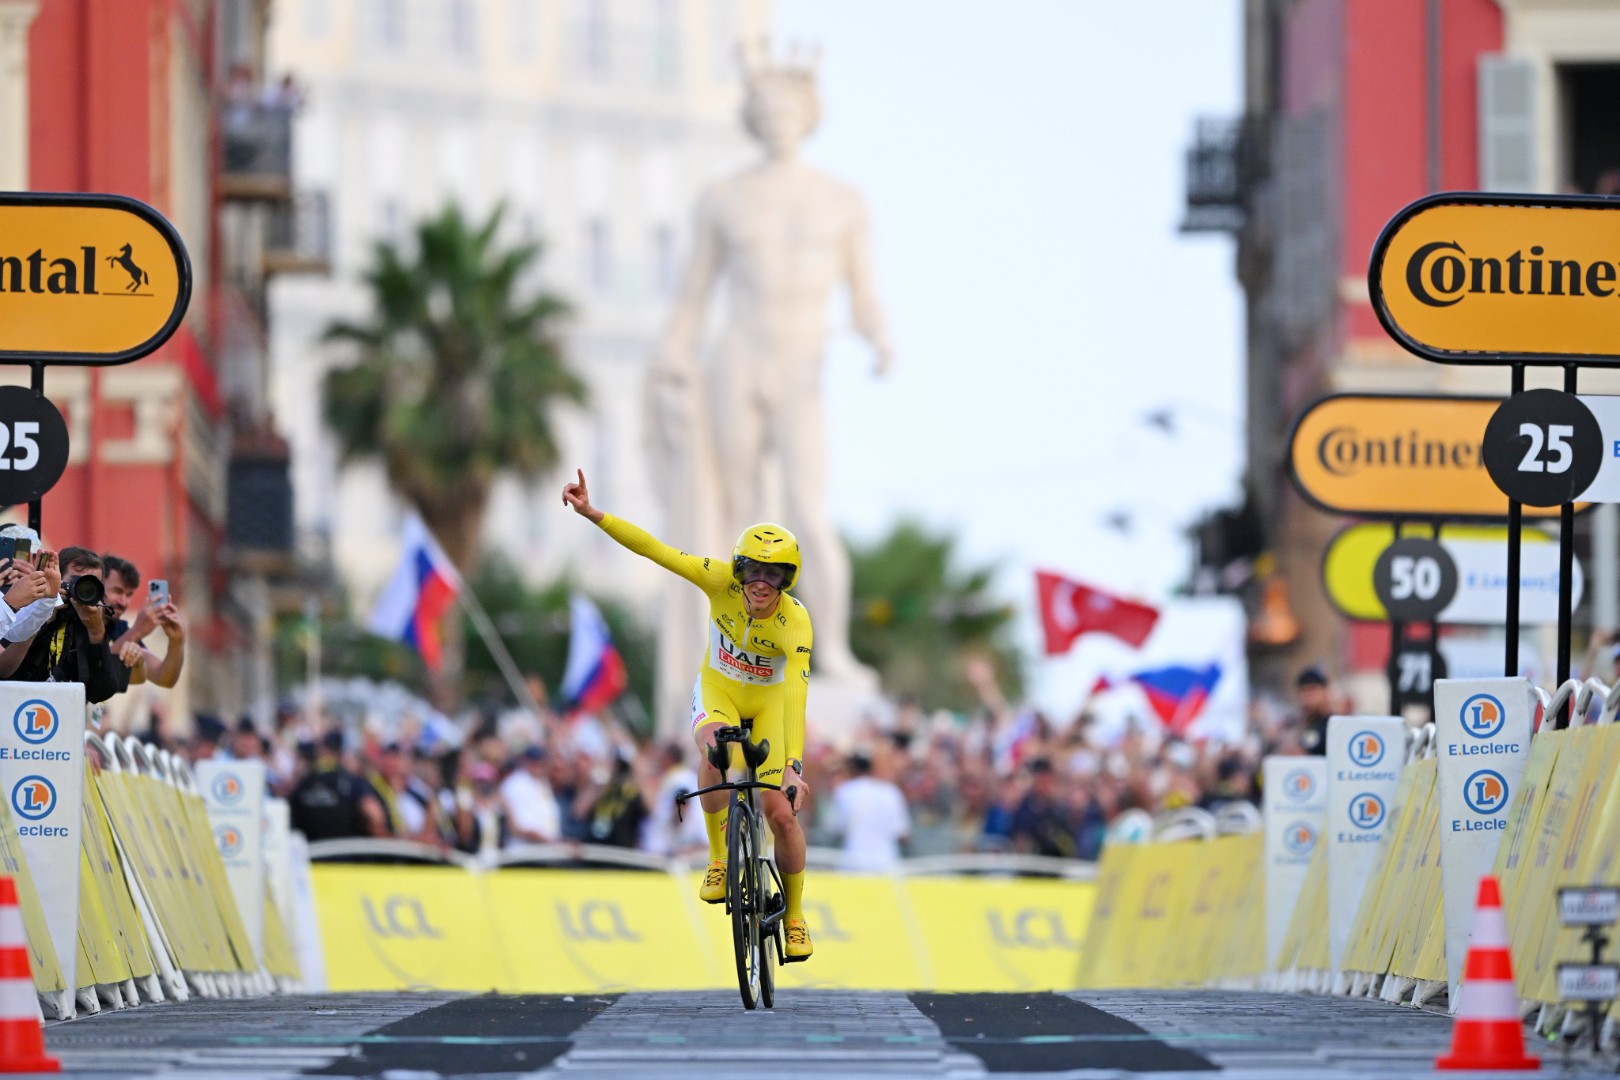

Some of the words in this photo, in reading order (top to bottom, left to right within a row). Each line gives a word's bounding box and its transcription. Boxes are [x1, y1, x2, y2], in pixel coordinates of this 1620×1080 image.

[1406, 240, 1620, 307] Contine
[1517, 423, 1574, 473] 25
[1391, 555, 1441, 600] 50
[720, 632, 772, 668] UAE
[753, 636, 780, 651] LCL
[720, 650, 772, 677] Emirates
[0, 748, 71, 761] E.Leclerc
[1448, 742, 1520, 756] E.Leclerc
[17, 825, 69, 837] eclerc
[1337, 833, 1383, 843] E.Lecle
[1452, 818, 1507, 832] E.Lecle
[360, 895, 442, 940] LCL
[555, 898, 644, 943] LCL
